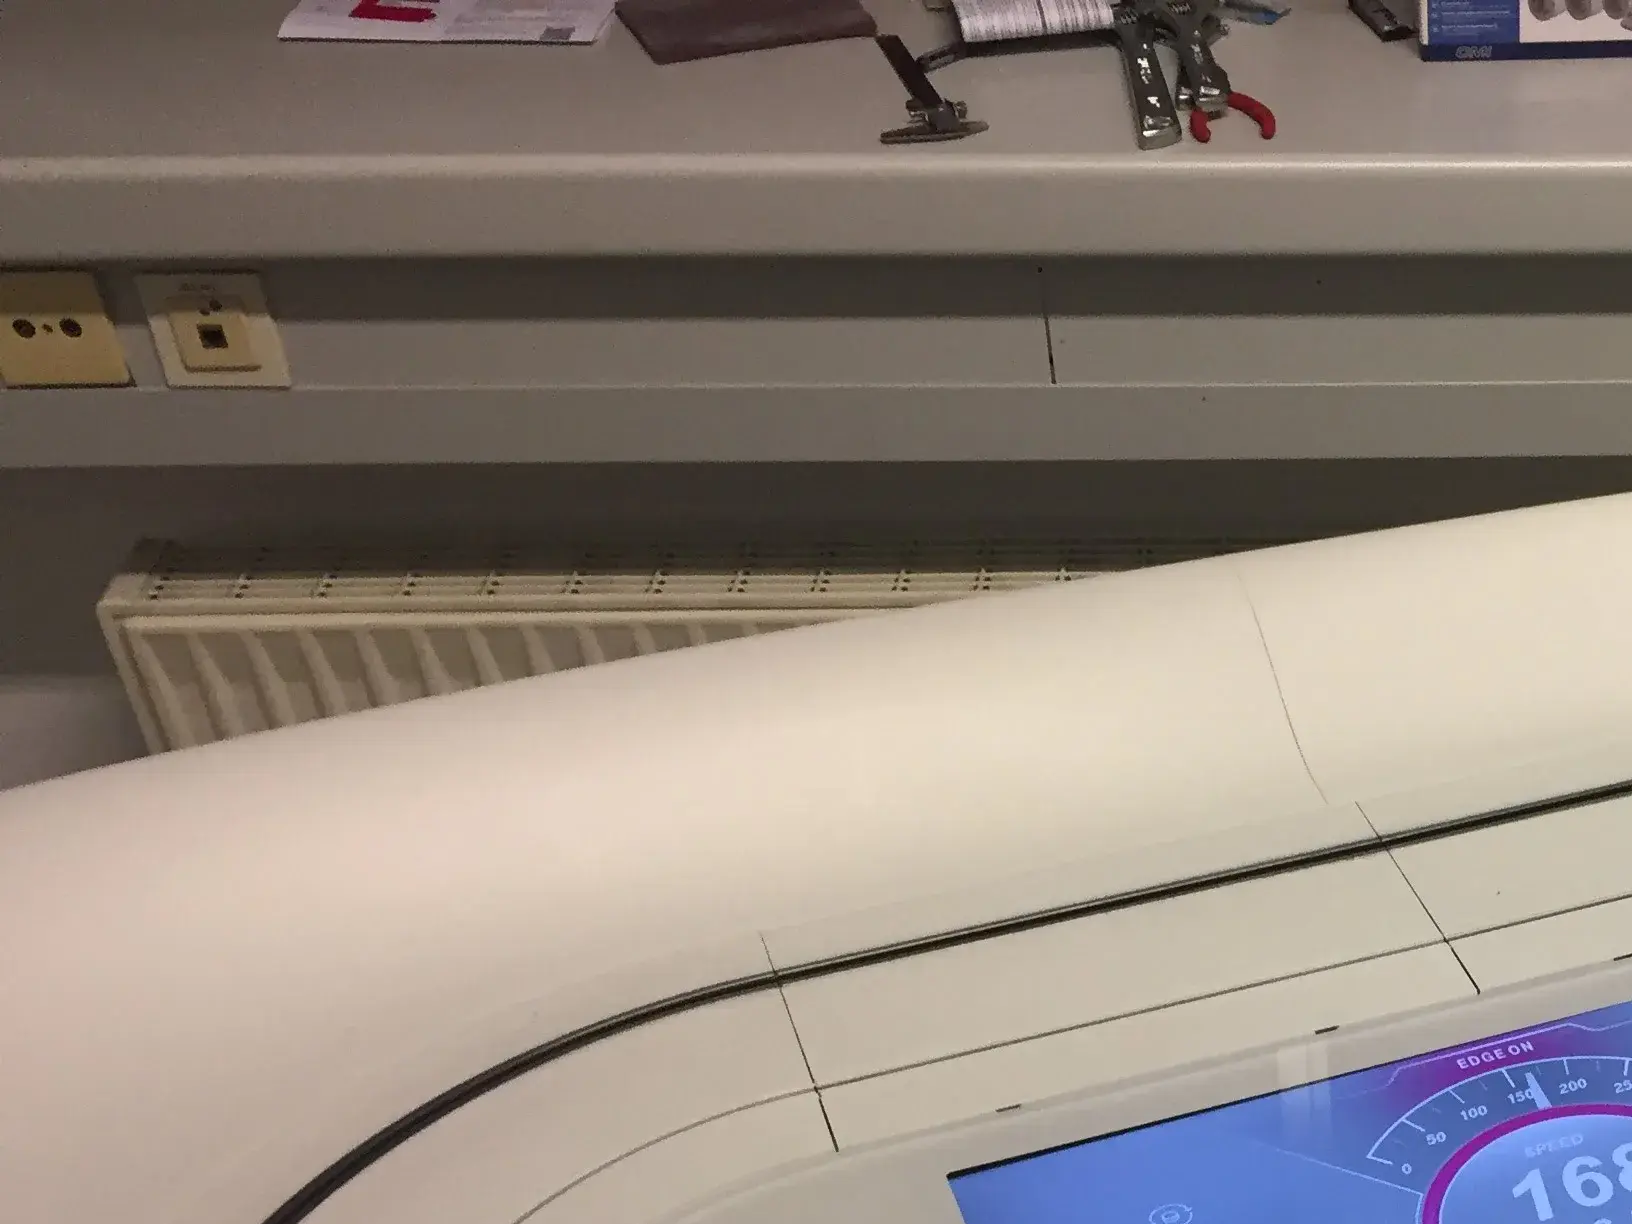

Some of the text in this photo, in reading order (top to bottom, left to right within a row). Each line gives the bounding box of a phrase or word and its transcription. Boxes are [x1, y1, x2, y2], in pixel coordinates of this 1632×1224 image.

[1456, 1040, 1535, 1070] EDGE ON
[1558, 1078, 1588, 1095] 200
[1507, 1087, 1535, 1104] 150
[1460, 1105, 1488, 1121] 100
[1426, 1131, 1447, 1146] 50
[1524, 1134, 1584, 1158] SPEED
[1401, 1163, 1413, 1175] 0
